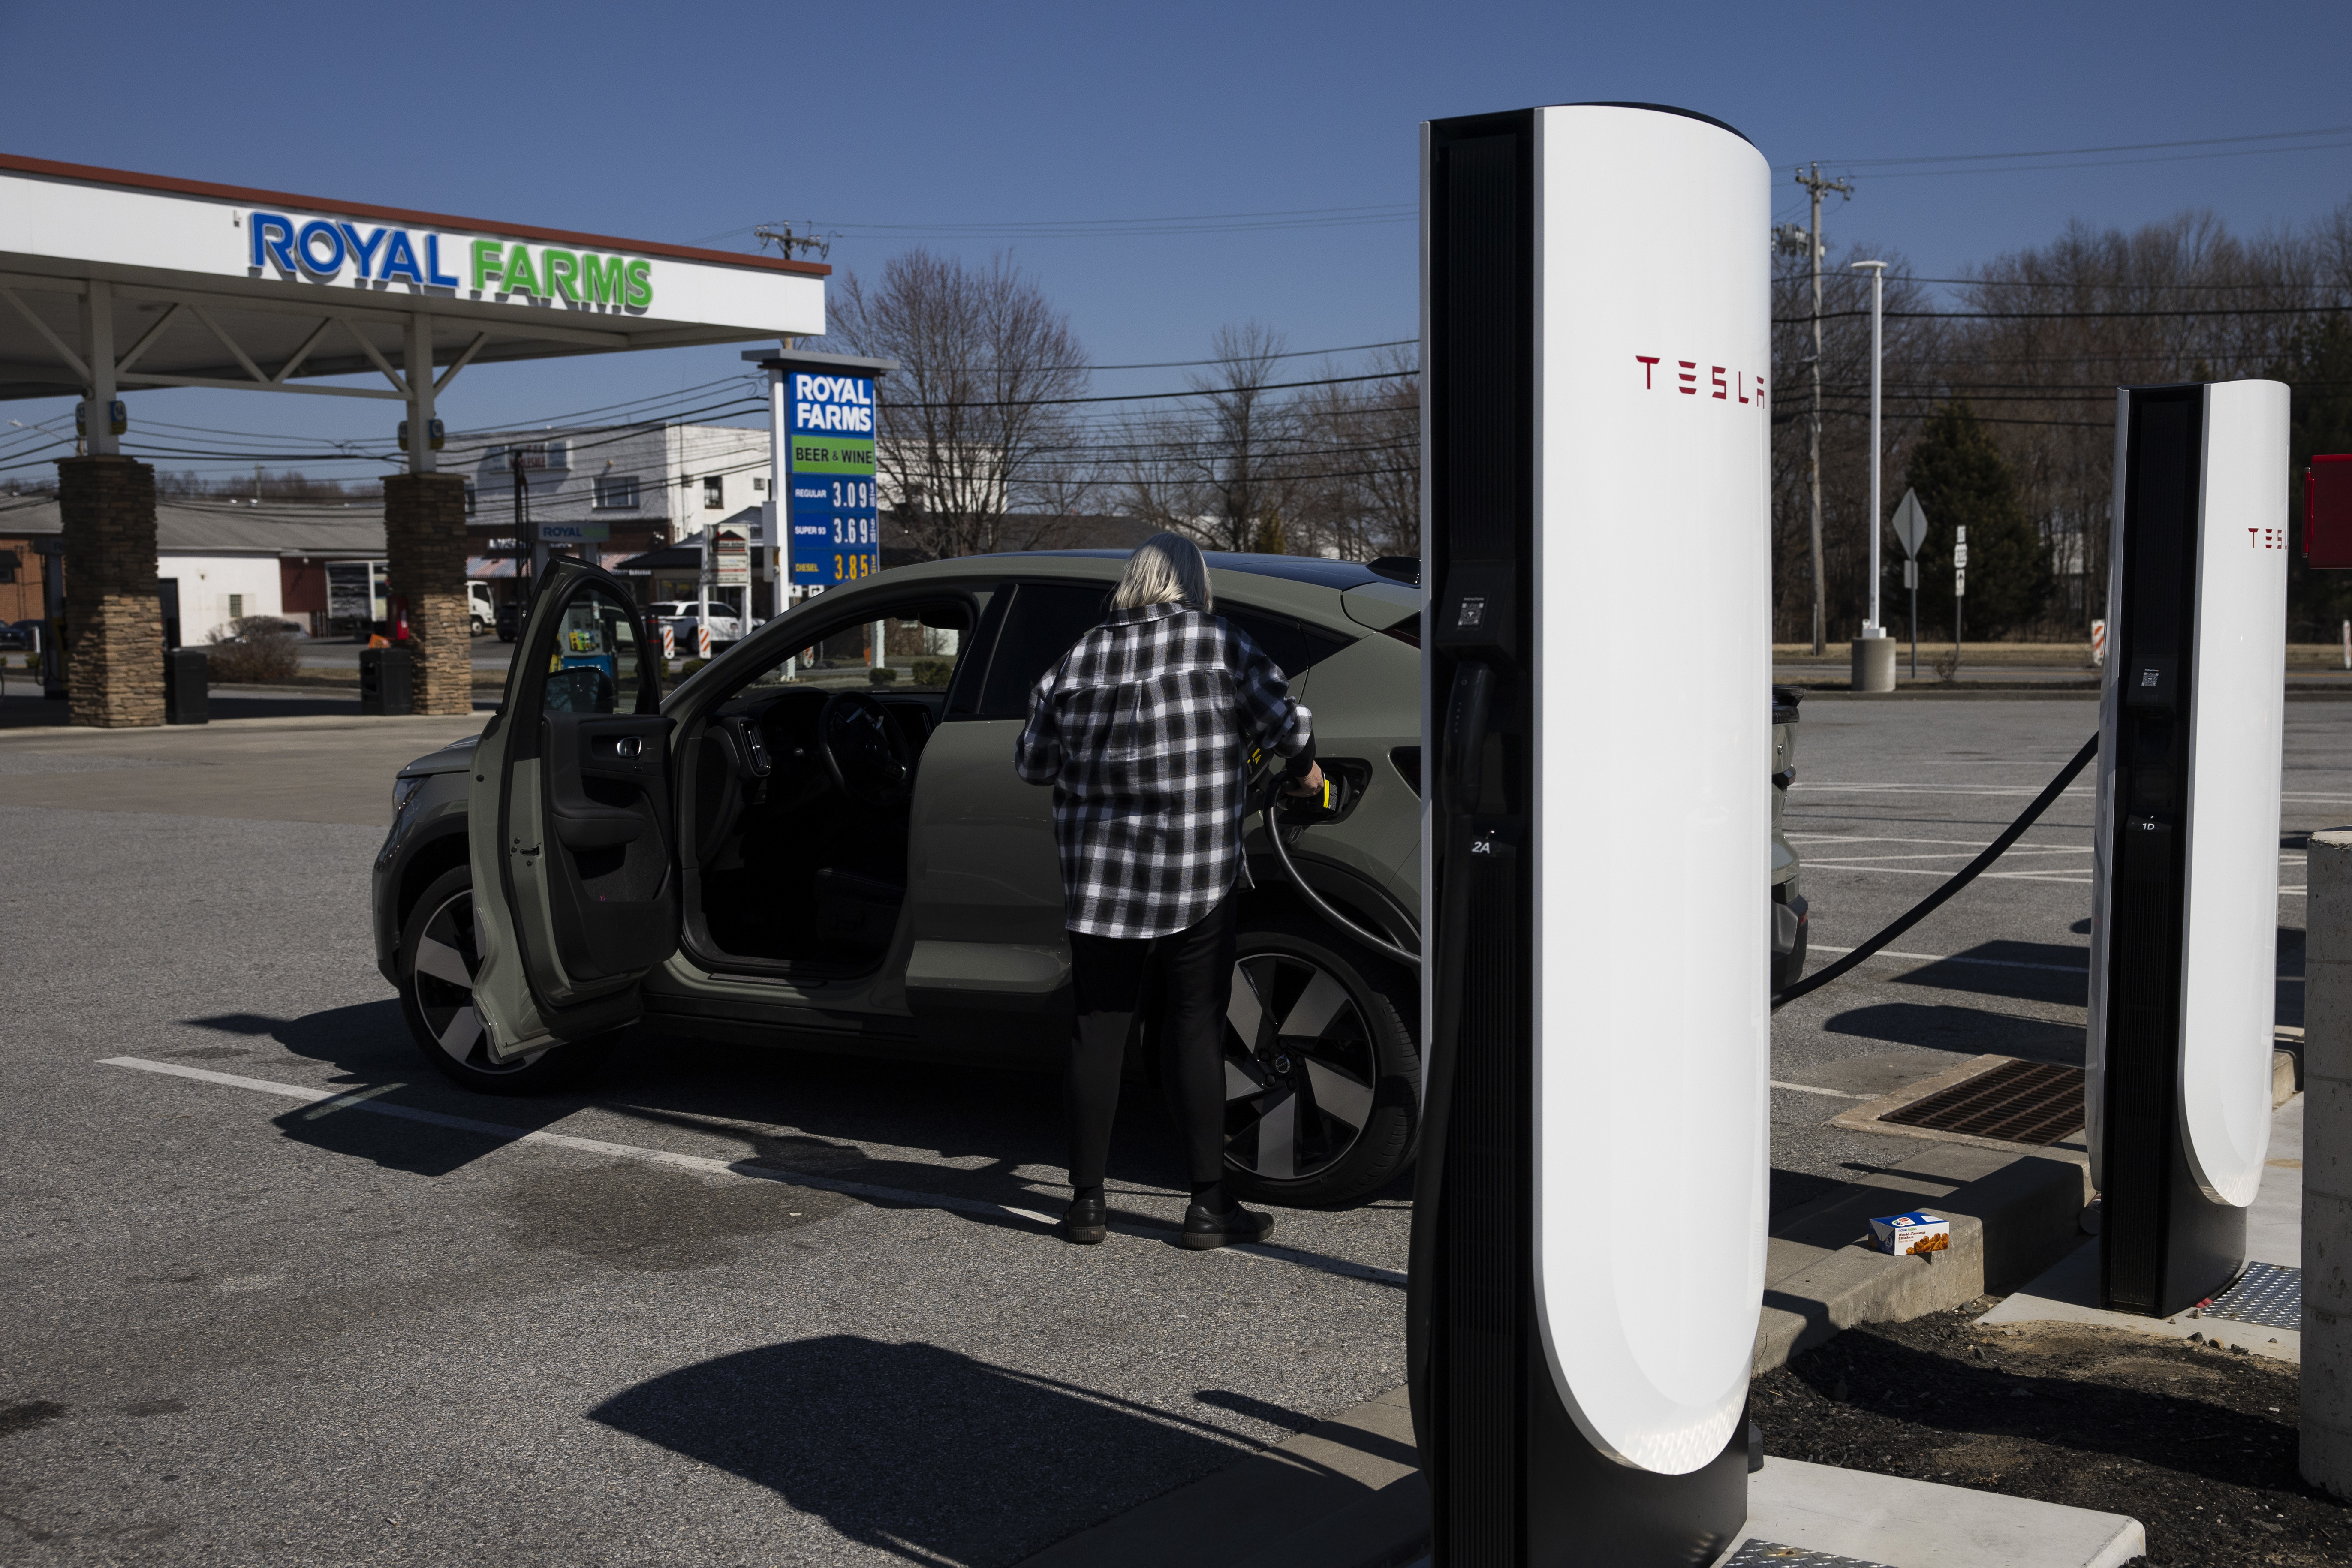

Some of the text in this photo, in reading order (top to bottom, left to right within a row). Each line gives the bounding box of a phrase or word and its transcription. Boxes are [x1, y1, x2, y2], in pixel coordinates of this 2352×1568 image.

[251, 212, 652, 309] ROYAL FARMS
[796, 374, 871, 405] ROYAL
[1635, 355, 1765, 409] TESLA
[797, 402, 872, 432] FARMS
[795, 447, 873, 464] BEER & WINE
[795, 488, 827, 498] REGULAR
[833, 482, 867, 508] 3.09
[543, 527, 582, 537] ROYAL
[795, 526, 817, 535] SUPER
[817, 527, 827, 535] 93
[833, 518, 868, 544] 3.69
[2248, 528, 2288, 550] TESL
[795, 563, 819, 572] DIESEL
[834, 554, 868, 580] 3.85
[1471, 841, 1490, 854] 2A
